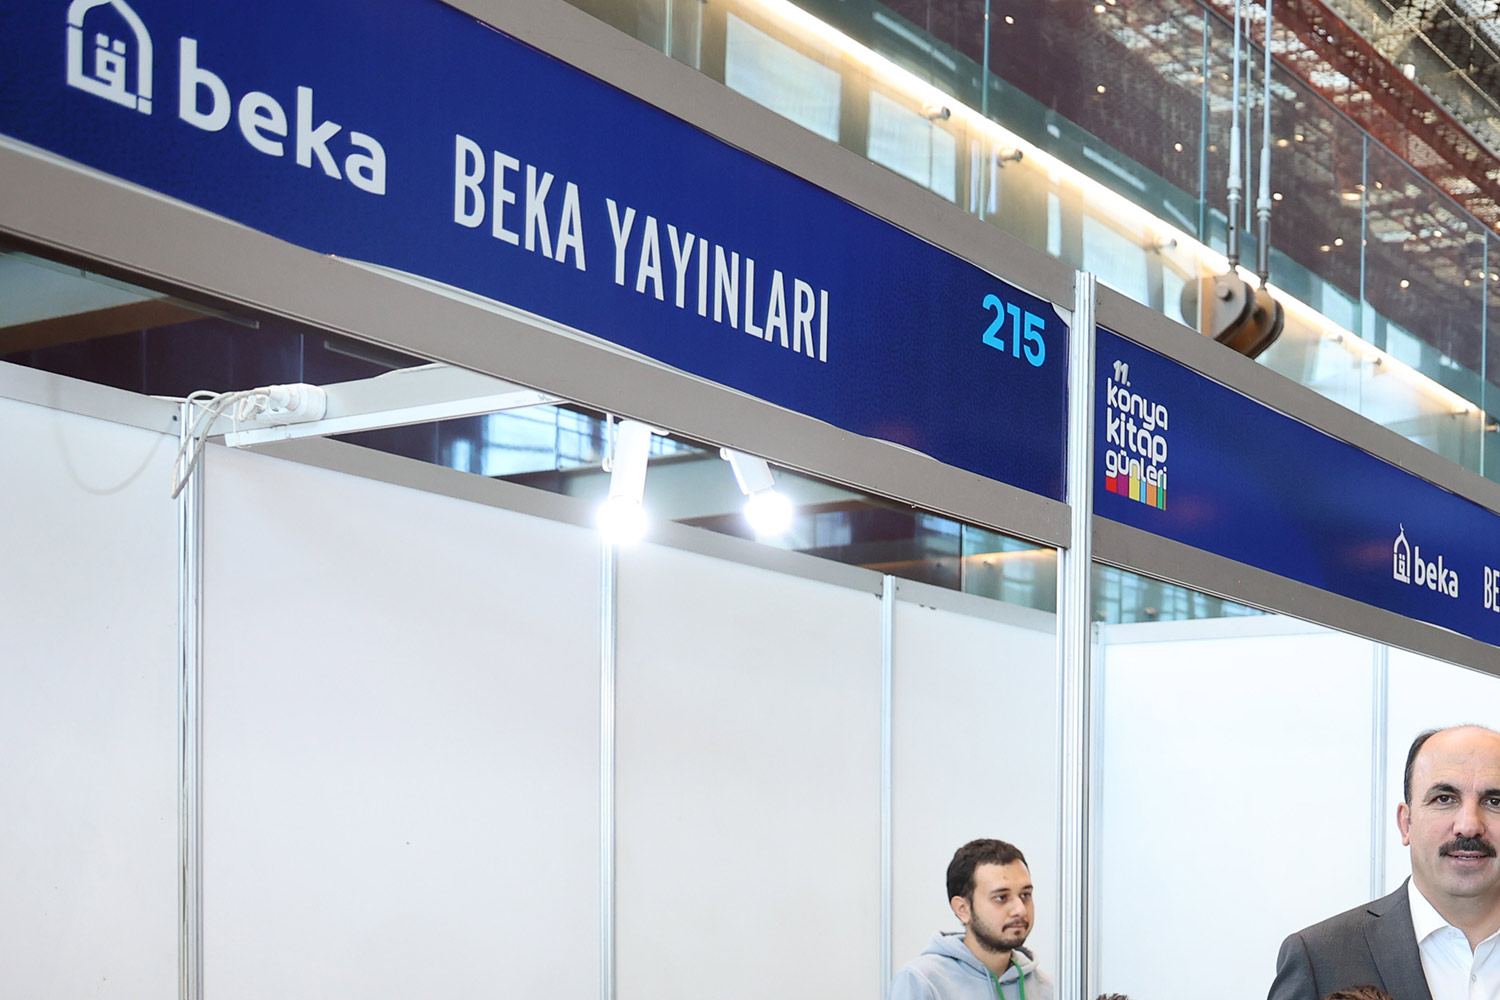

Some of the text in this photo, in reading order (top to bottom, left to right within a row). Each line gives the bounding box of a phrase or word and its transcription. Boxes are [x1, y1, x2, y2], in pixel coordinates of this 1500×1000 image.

[179, 37, 388, 195] beka
[453, 134, 586, 271] BEKA
[606, 197, 831, 362] YAYINLARI
[982, 293, 1046, 368] 215
[1112, 359, 1132, 387] 11.
[1107, 377, 1168, 431] konya
[1106, 407, 1167, 466] kitap
[1105, 449, 1167, 490] günleri
[1414, 546, 1459, 598] beka
